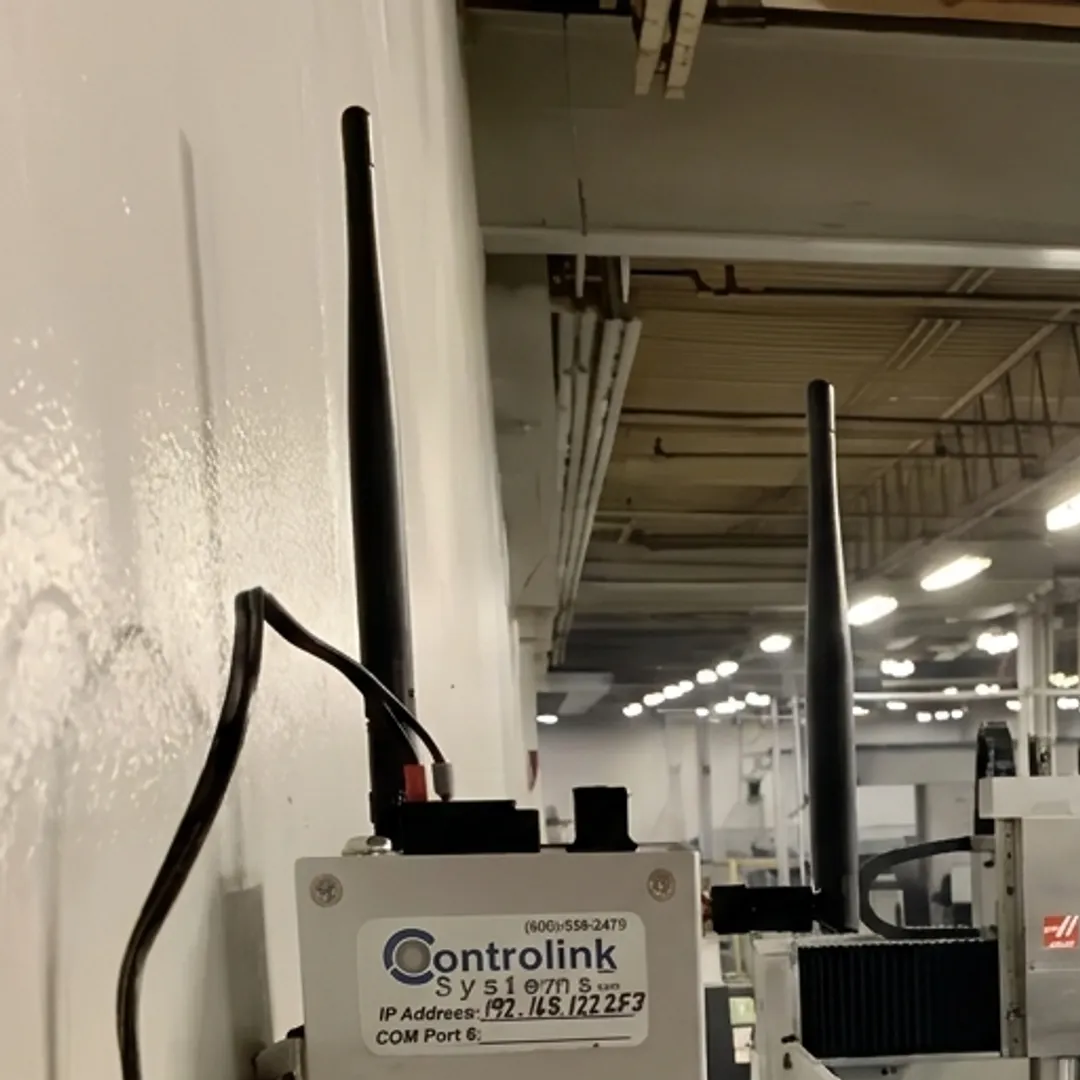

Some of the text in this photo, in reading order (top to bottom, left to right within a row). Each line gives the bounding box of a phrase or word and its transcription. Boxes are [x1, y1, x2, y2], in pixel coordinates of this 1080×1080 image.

[382, 928, 618, 986] Controlink
[379, 1006, 398, 1021] IP
[375, 1029, 419, 1045] COM
[424, 1027, 462, 1043] Port
